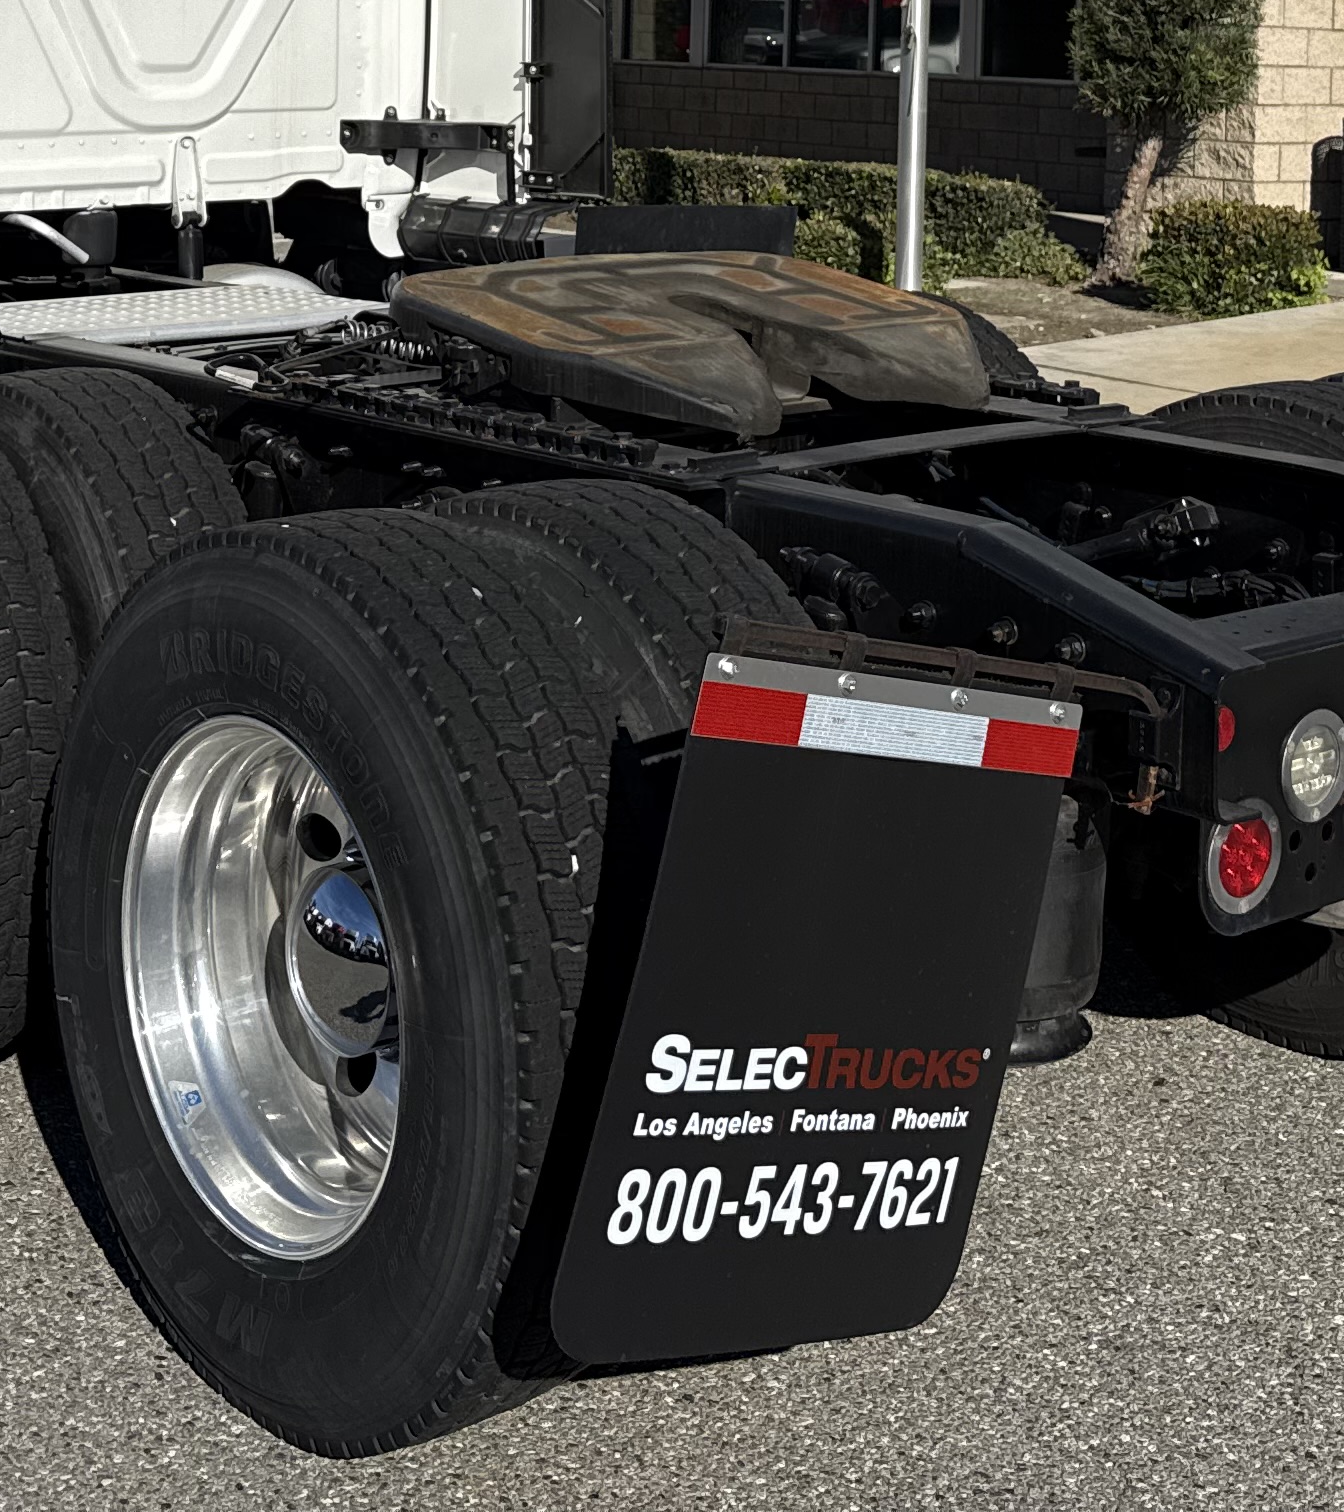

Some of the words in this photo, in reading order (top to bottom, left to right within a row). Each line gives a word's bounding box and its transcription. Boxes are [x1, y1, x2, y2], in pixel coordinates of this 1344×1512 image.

[159, 628, 409, 872] BRIDGESTONE
[633, 1112, 677, 1138] Los
[683, 1110, 774, 1141] Angeles
[789, 1108, 875, 1132] Fontana
[891, 1106, 969, 1131] Phoenix
[606, 1156, 960, 1246] 800-543-7621
